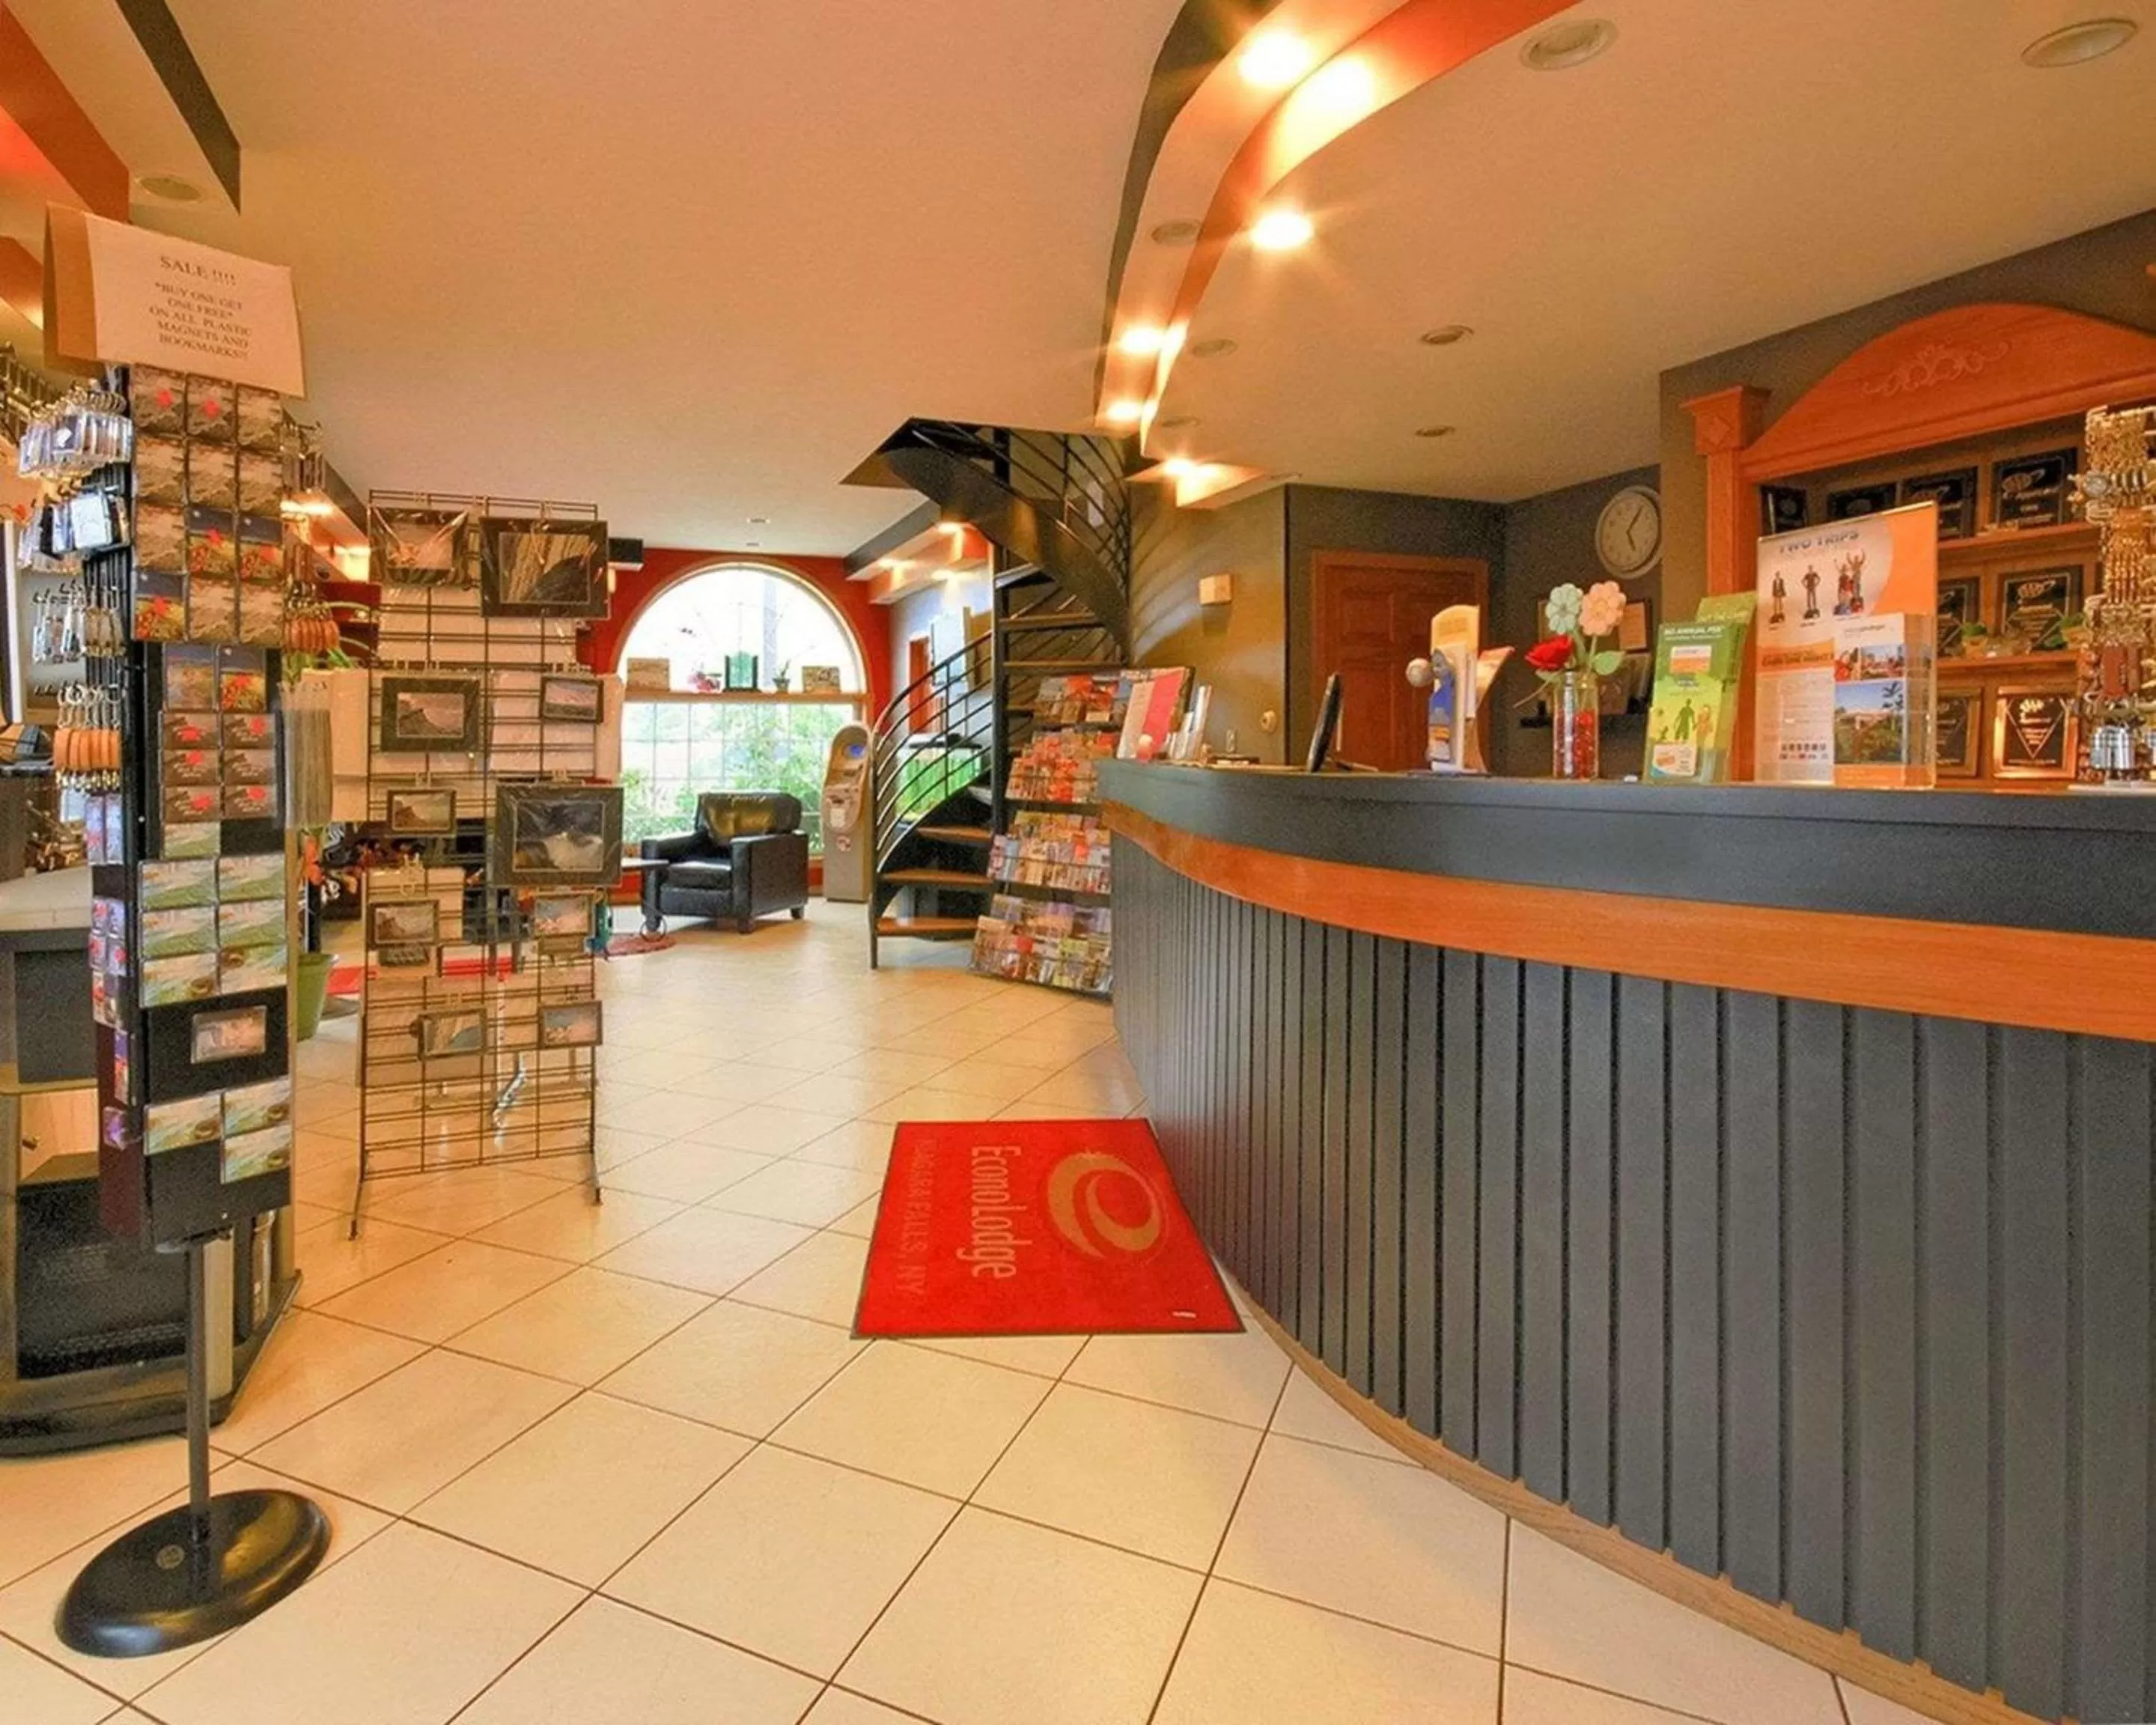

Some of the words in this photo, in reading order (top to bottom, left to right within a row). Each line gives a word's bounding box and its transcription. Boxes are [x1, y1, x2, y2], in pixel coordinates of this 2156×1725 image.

[160, 256, 207, 279] SALE
[168, 296, 192, 310] ONE
[190, 291, 214, 303] ONE
[219, 298, 243, 311] GET
[149, 304, 169, 317] ON
[203, 317, 252, 335] PLASTIC
[158, 320, 219, 341] MAGNETS
[222, 335, 249, 349] AND
[954, 1146, 1034, 1280] EconoLodge
[895, 1265, 929, 1296] NY
